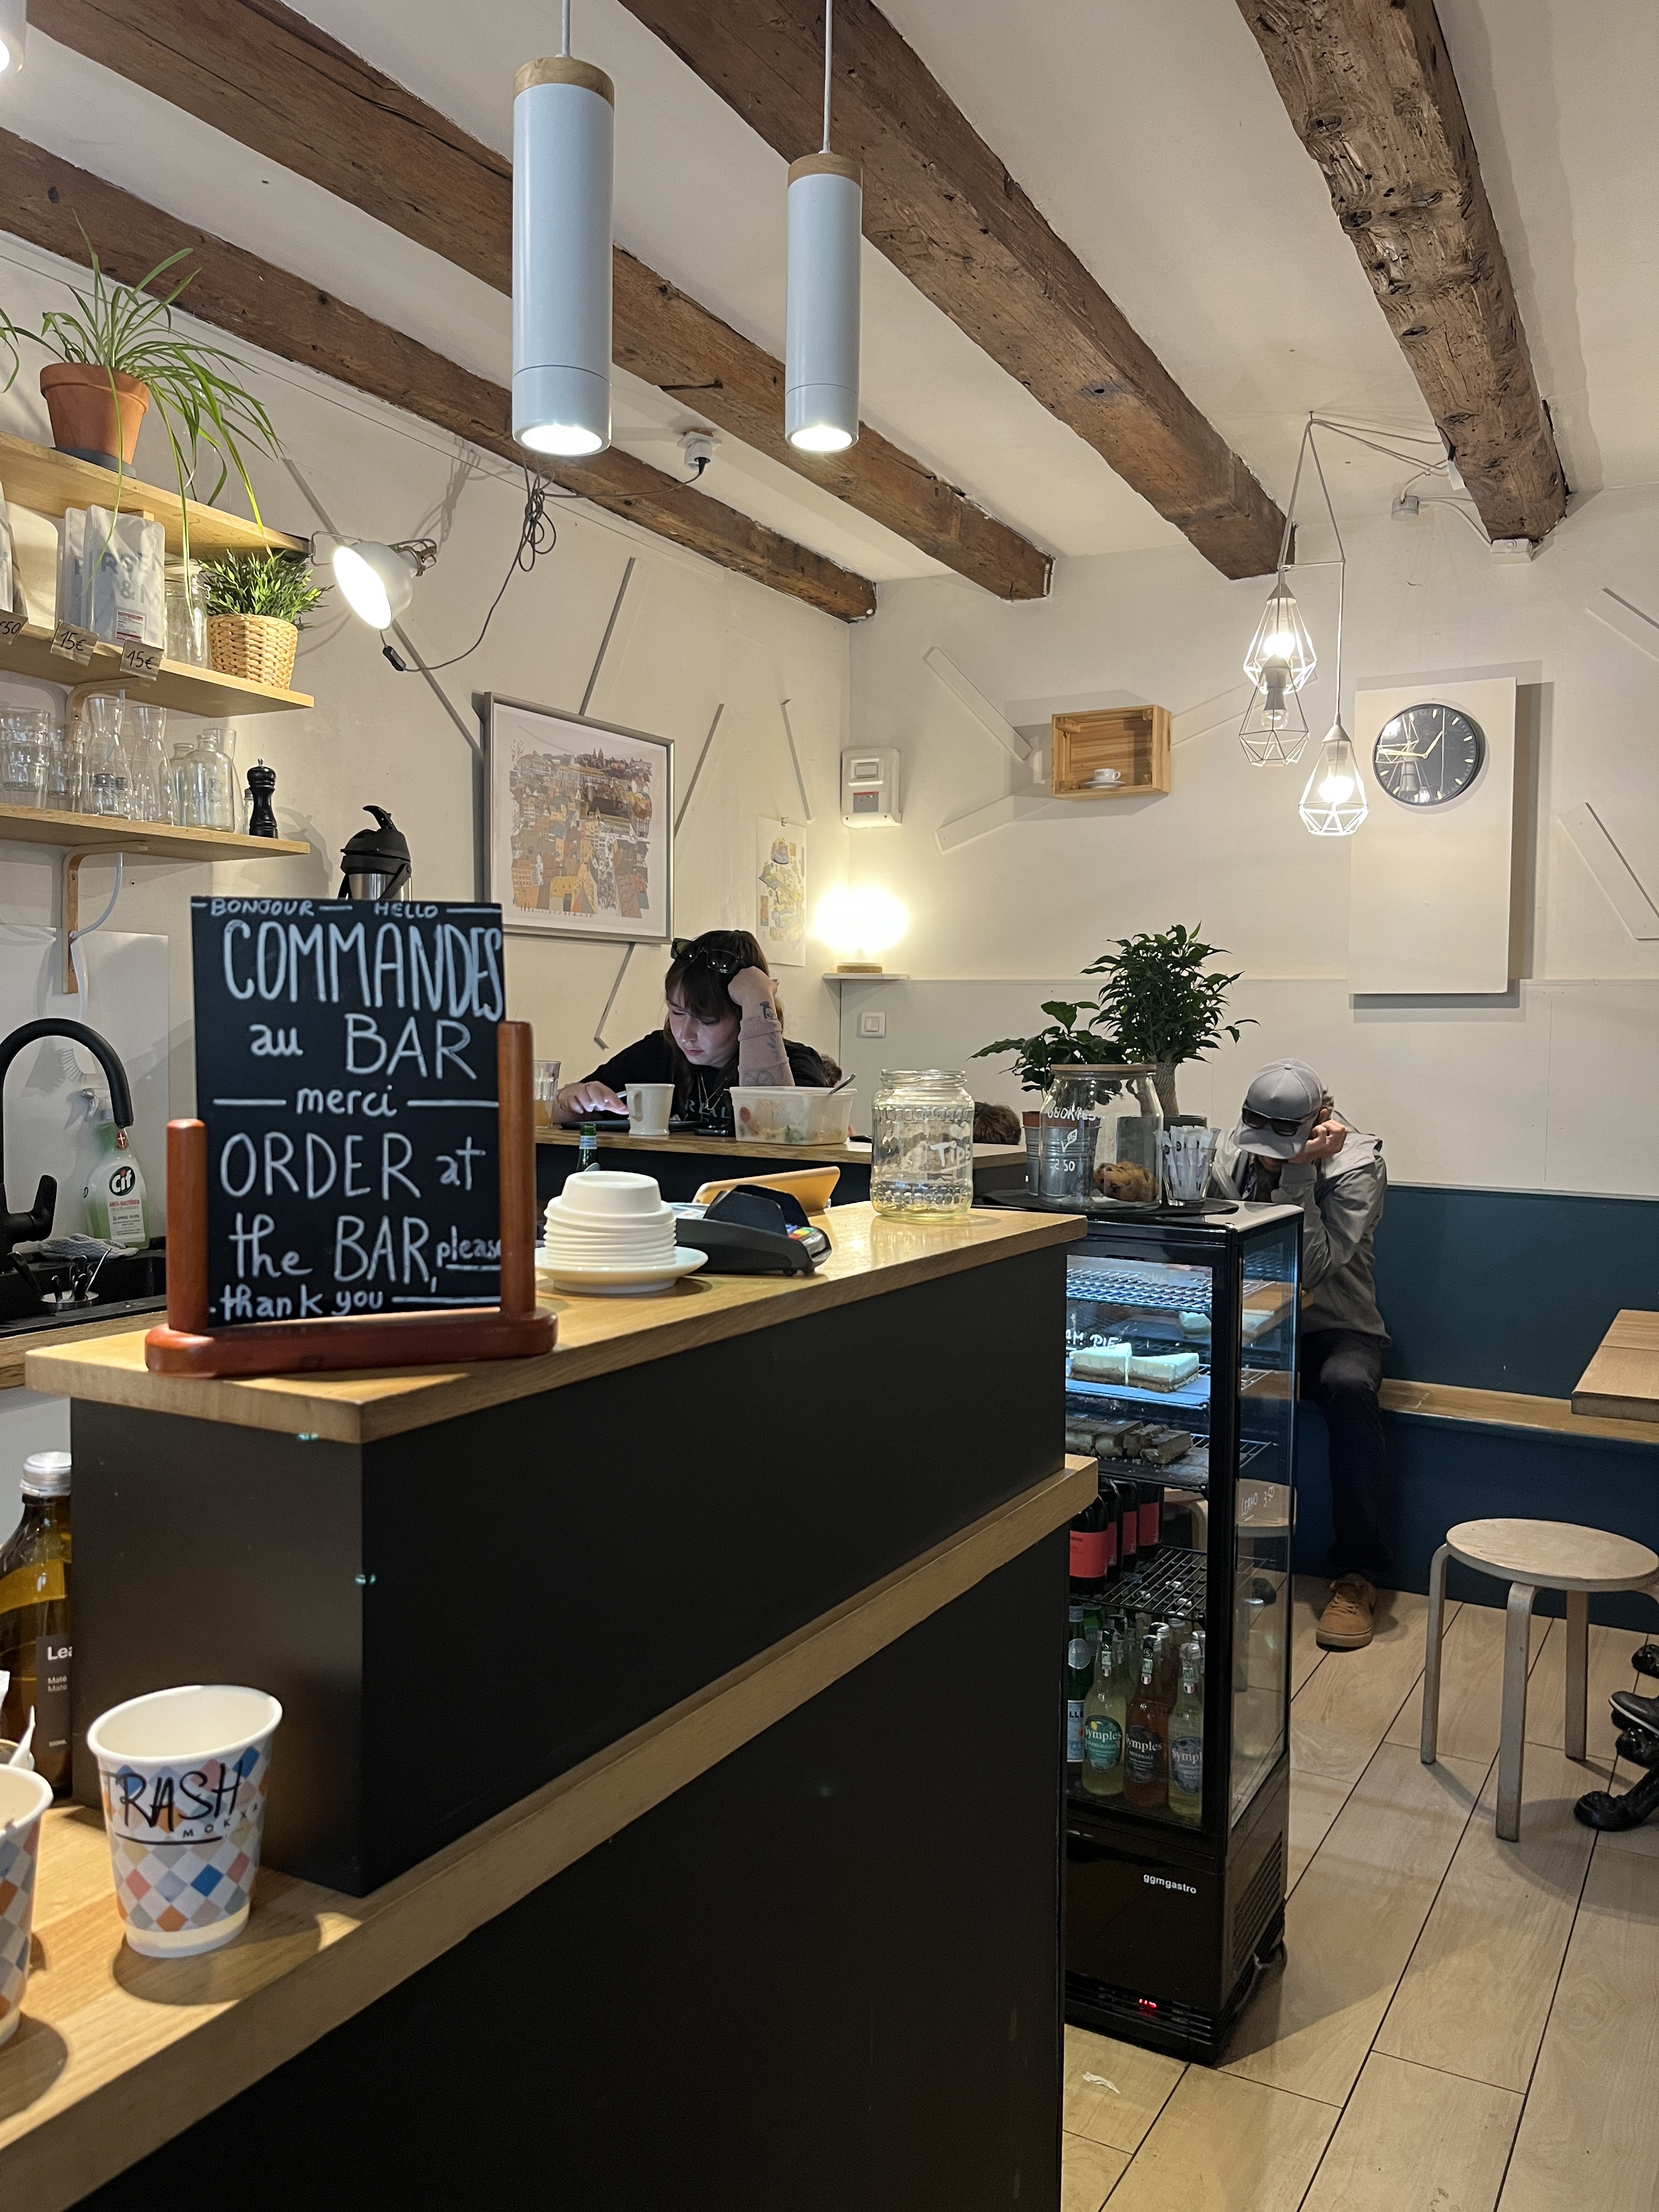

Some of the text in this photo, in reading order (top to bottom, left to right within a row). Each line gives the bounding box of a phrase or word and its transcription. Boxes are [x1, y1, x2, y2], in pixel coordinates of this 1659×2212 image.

[120, 579, 135, 601] &
[61, 631, 86, 651] 15€
[127, 651, 155, 669] 15€
[211, 899, 438, 918] BONJOUR HELLO
[224, 920, 503, 1021] COMMANDES
[250, 1013, 476, 1080] au BAR
[297, 1086, 398, 1116] merci
[220, 1132, 486, 1200] ORDER at
[112, 1169, 132, 1193] Cif
[229, 1212, 313, 1278] the
[220, 1284, 383, 1321] thank you
[1085, 1725, 1121, 1742] Symples
[1144, 1874, 1197, 1894] ggmgastro
